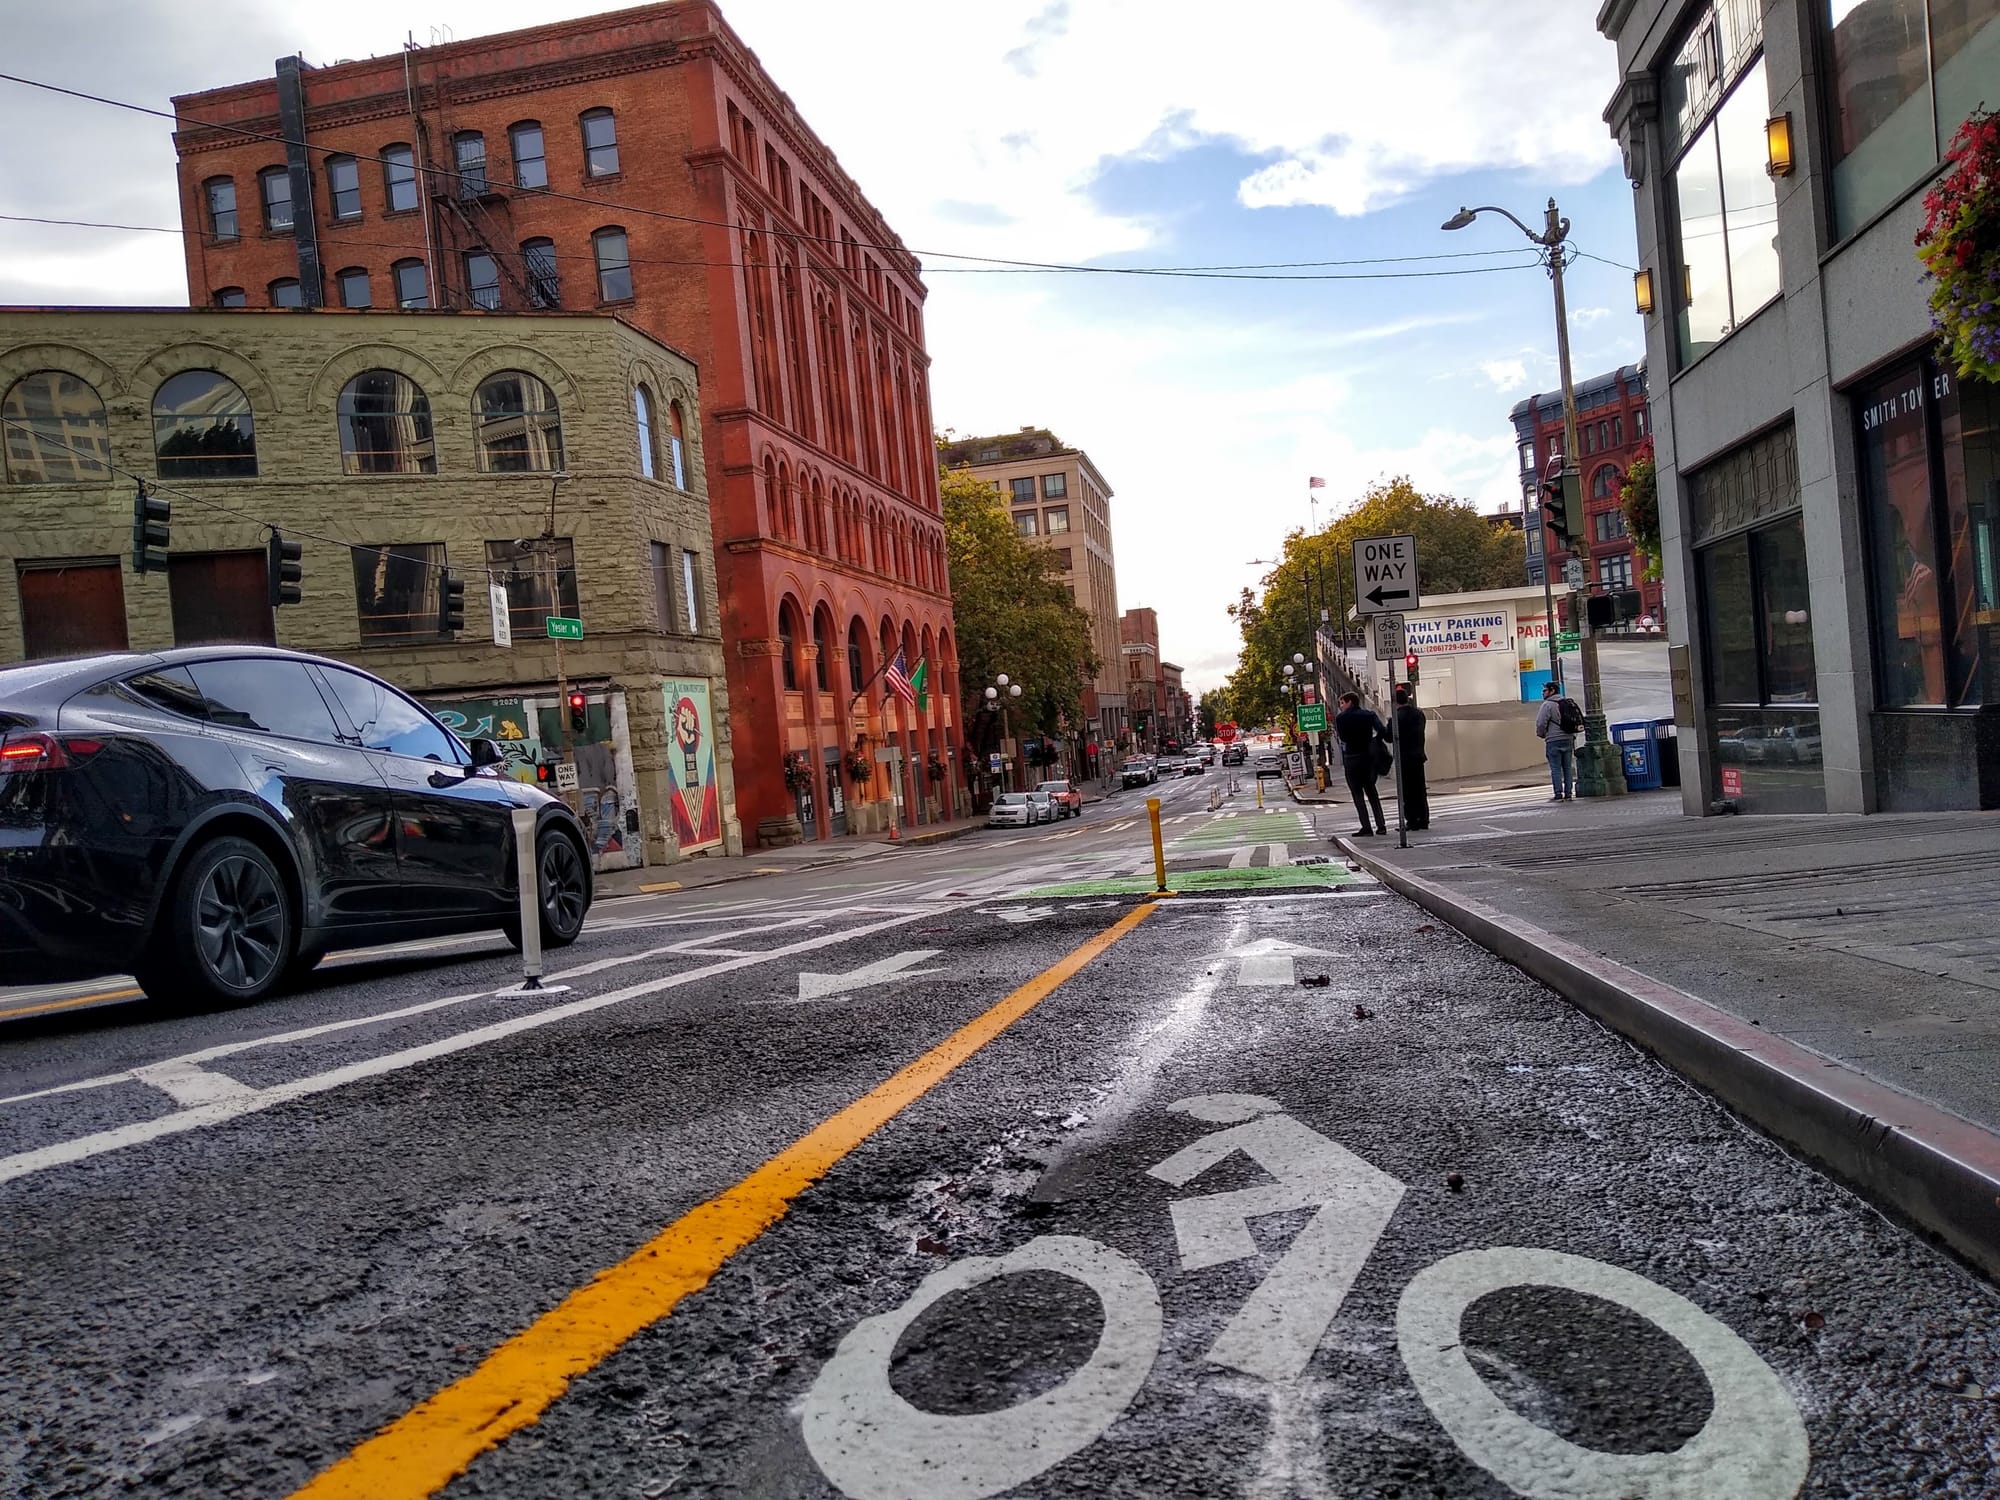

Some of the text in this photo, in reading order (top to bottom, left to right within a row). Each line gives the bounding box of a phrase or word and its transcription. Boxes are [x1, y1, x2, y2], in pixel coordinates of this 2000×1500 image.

[1864, 397, 1897, 431] SMITH
[1364, 542, 1405, 561] ONE
[1364, 563, 1407, 582] WAY
[551, 621, 568, 633] Yesler
[1404, 616, 1503, 633] NTHLY PARKING
[499, 630, 507, 640] RED
[1409, 631, 1477, 645] AVAILABLE
[1379, 646, 1403, 655] SIGNAL
[1218, 729, 1235, 737] STOP
[557, 765, 575, 773] ONE
[558, 773, 576, 781] WAY
